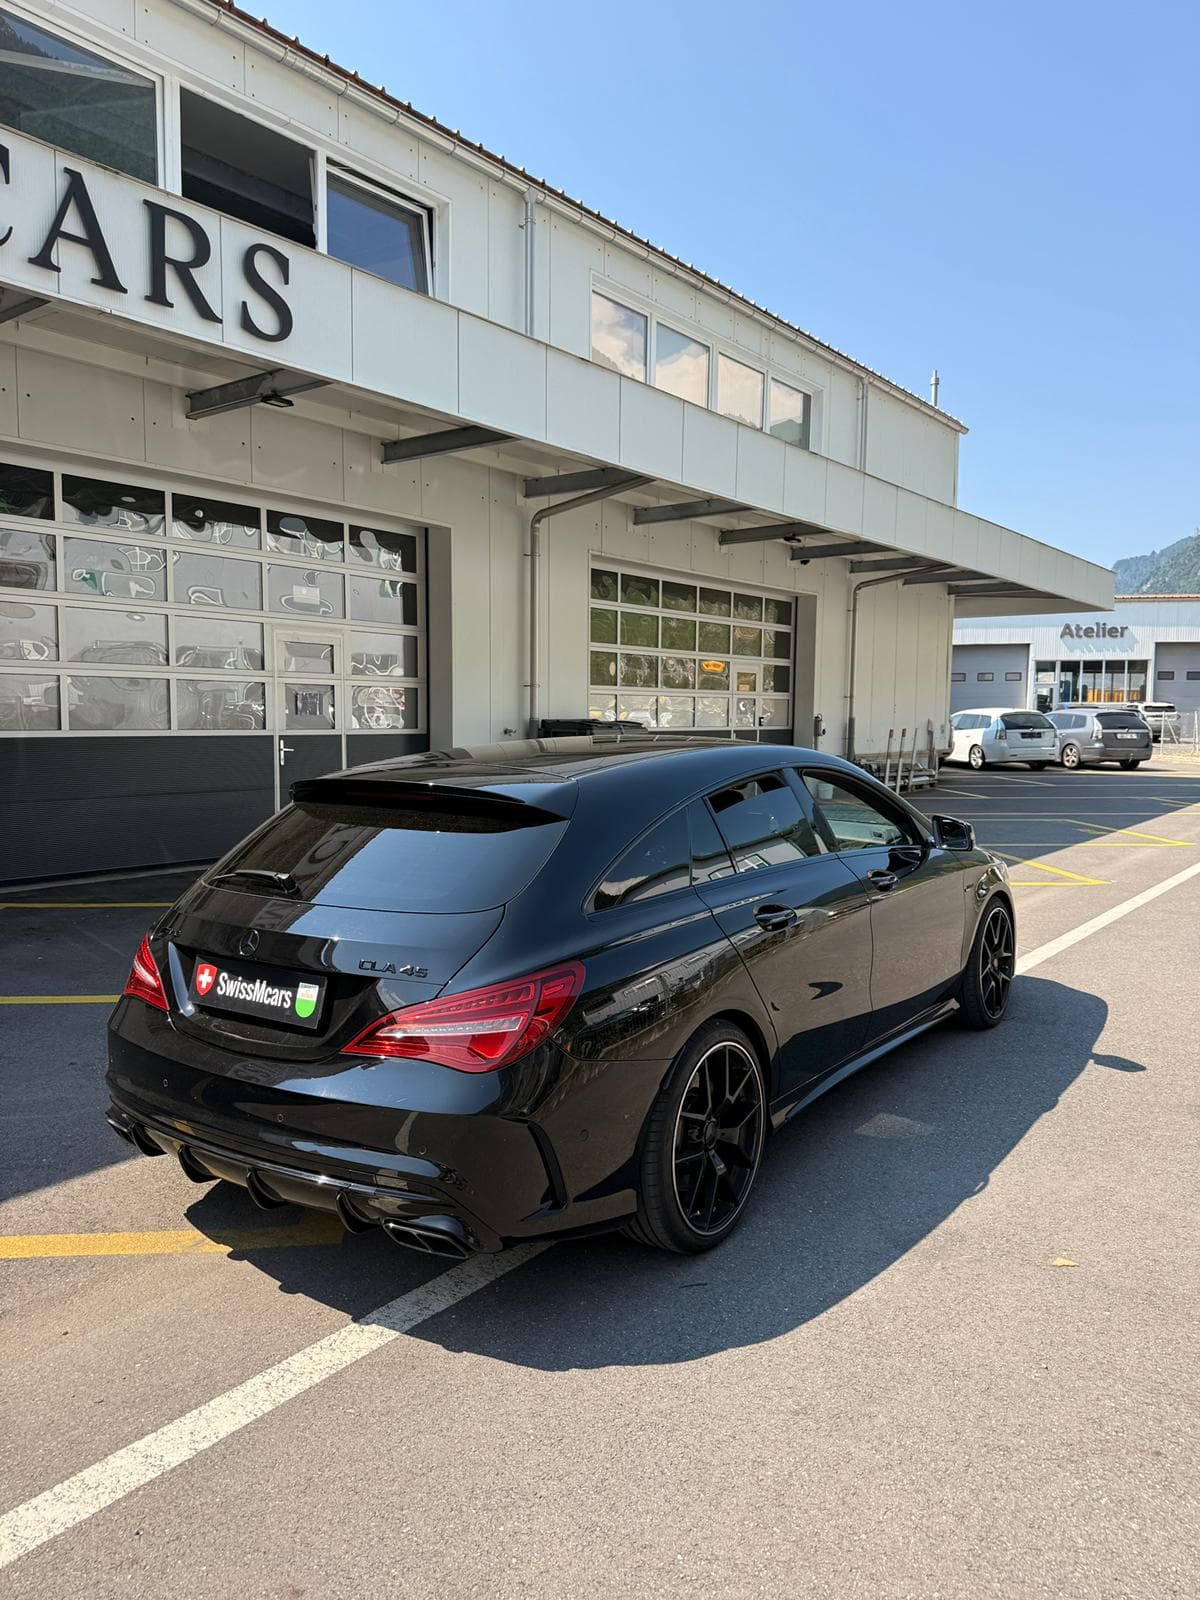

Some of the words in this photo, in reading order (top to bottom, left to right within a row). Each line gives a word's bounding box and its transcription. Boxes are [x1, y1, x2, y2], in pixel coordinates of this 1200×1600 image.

[0, 143, 293, 342] ARS
[1060, 622, 1128, 639] Atelier
[359, 959, 396, 974] CLA
[399, 965, 429, 978] 45
[217, 972, 293, 1009] SwissMcars
